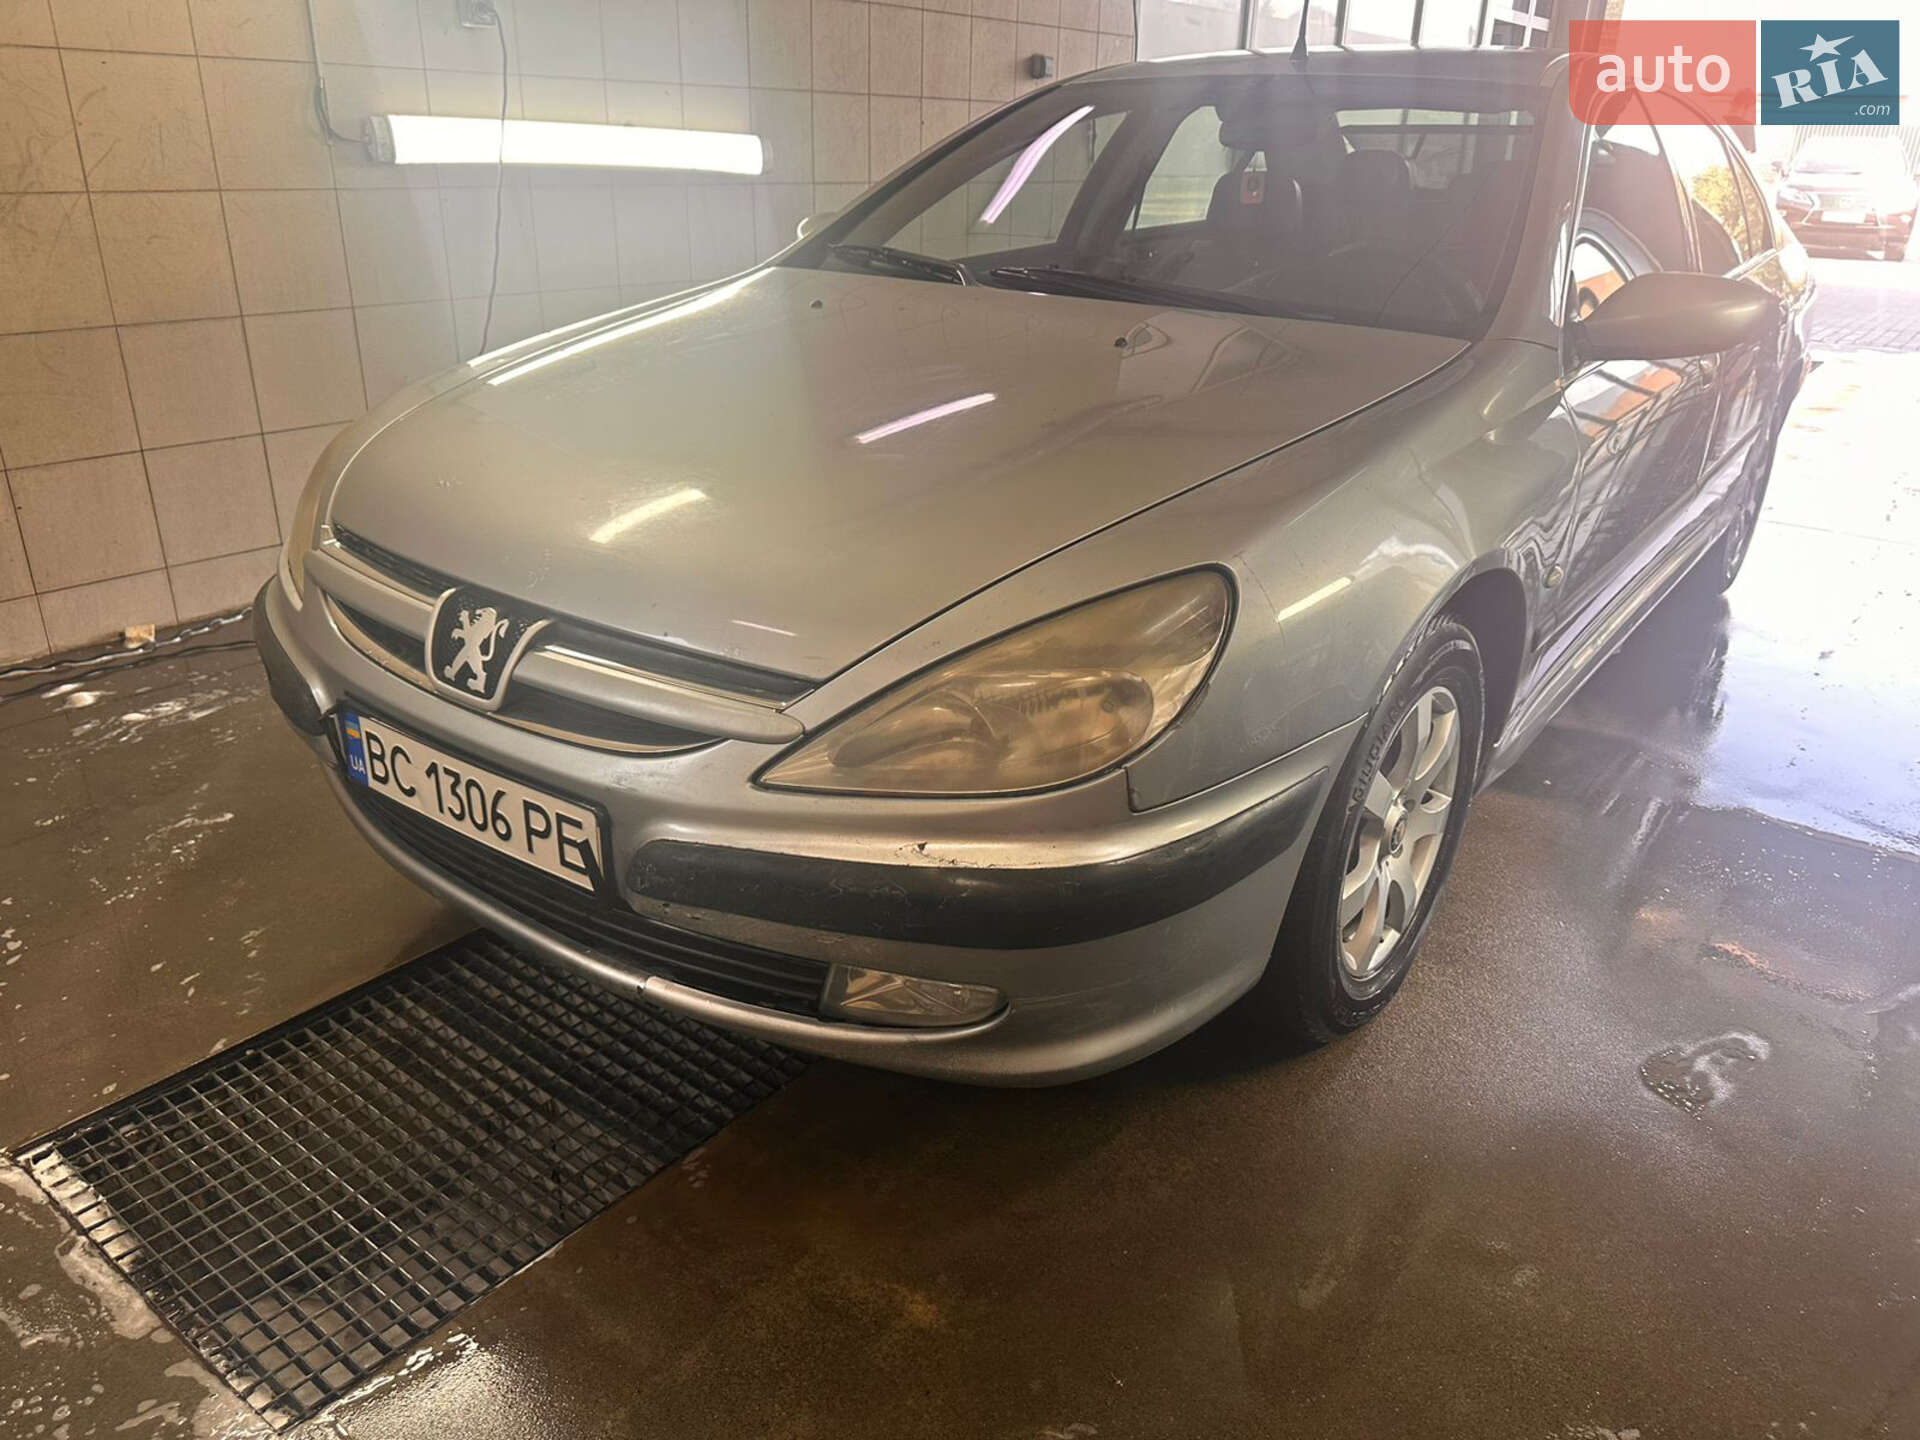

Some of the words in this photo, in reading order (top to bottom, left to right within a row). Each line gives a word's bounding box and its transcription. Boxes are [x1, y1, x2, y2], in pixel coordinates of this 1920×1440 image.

[349, 754, 367, 776] UA
[365, 730, 417, 798] BC
[425, 761, 513, 842] 1306
